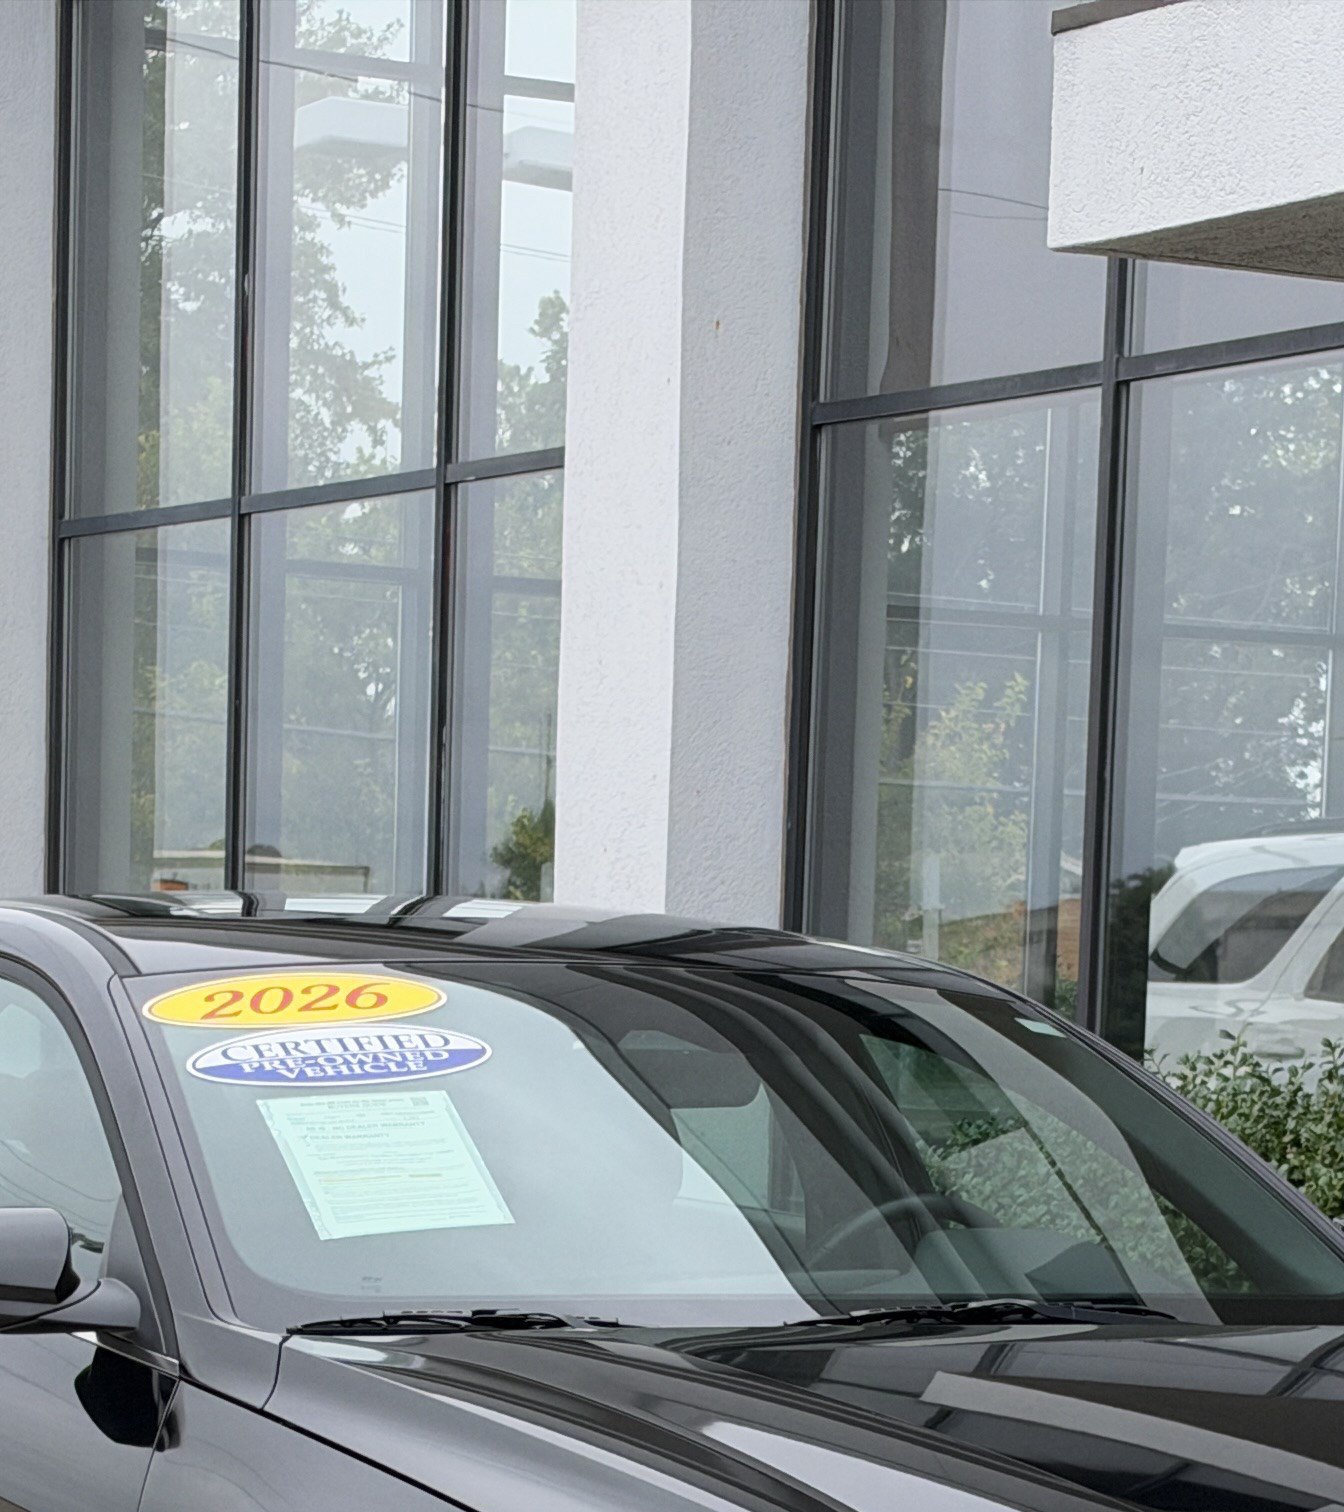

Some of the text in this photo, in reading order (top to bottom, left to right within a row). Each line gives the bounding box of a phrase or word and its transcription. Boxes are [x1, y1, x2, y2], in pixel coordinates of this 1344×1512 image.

[201, 984, 389, 1020] 2026
[222, 1033, 450, 1062] CERTIFIED
[240, 1049, 450, 1074] PRE-OWNED
[278, 1059, 428, 1080] VEHICLE
